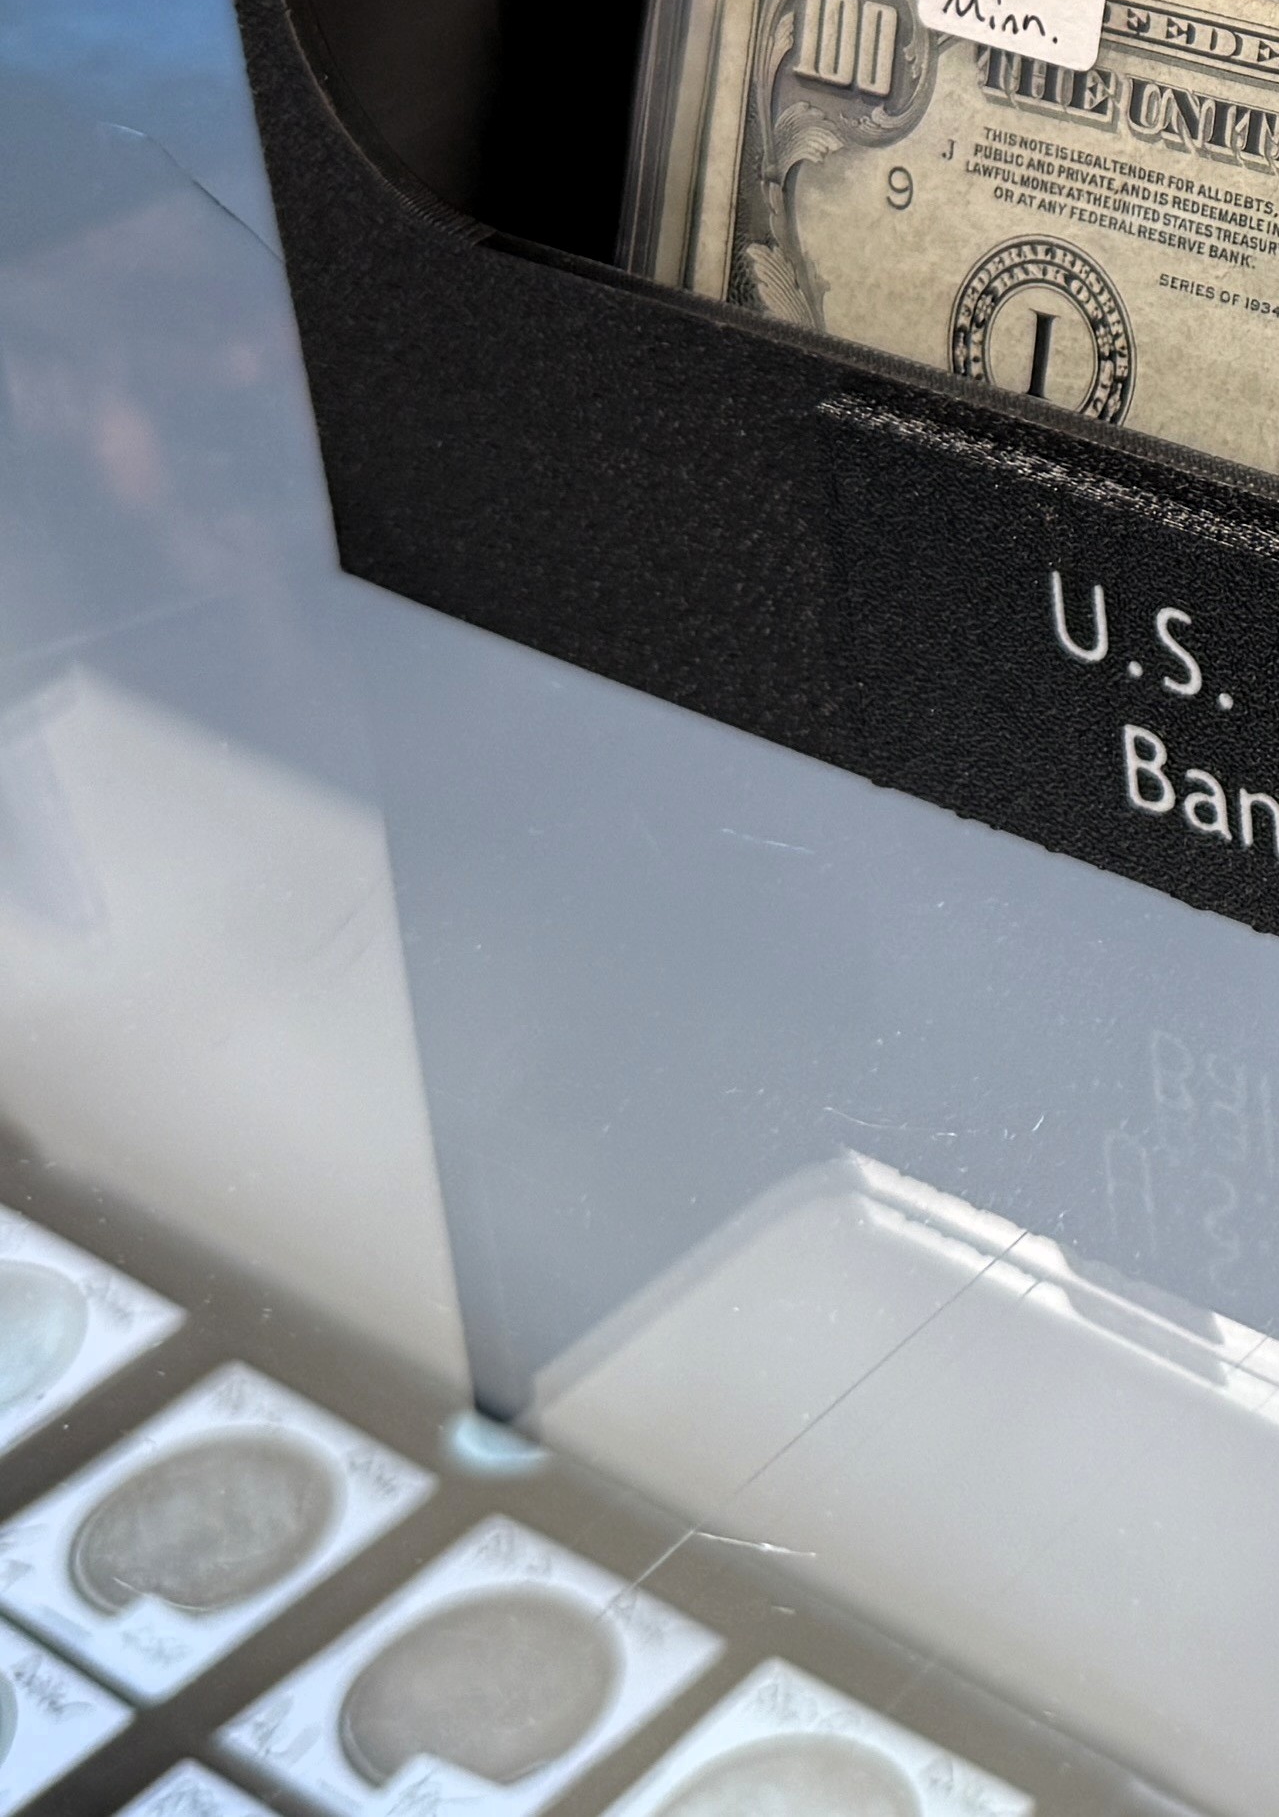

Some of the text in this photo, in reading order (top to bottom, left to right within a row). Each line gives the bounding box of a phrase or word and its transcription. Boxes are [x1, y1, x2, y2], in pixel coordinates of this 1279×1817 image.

[886, 164, 915, 211] 9
[965, 160, 1019, 185] LAWFUL
[1020, 173, 1066, 197] MONEY
[1066, 185, 1084, 201] AT
[1083, 190, 1111, 210] THE
[1112, 197, 1161, 223] UNITED
[1162, 212, 1214, 239] STATES
[973, 143, 1024, 168] PUBLIC
[1025, 156, 1056, 176] AND
[1057, 164, 1119, 196] PRIVATE,
[1120, 182, 1151, 201] AND
[1153, 190, 1169, 206] IS
[1171, 195, 1264, 234] REDEEMABLE
[983, 126, 1279, 218] THIS NOTE IS LEGAL TENDER FOR ALL DEBTS,
[993, 185, 1256, 270] OR AT ANY FEDERAL RESERVE BANK.
[1158, 272, 1216, 300] SERIES
[1219, 290, 1241, 306] OF
[1050, 570, 1234, 711] U.S.
